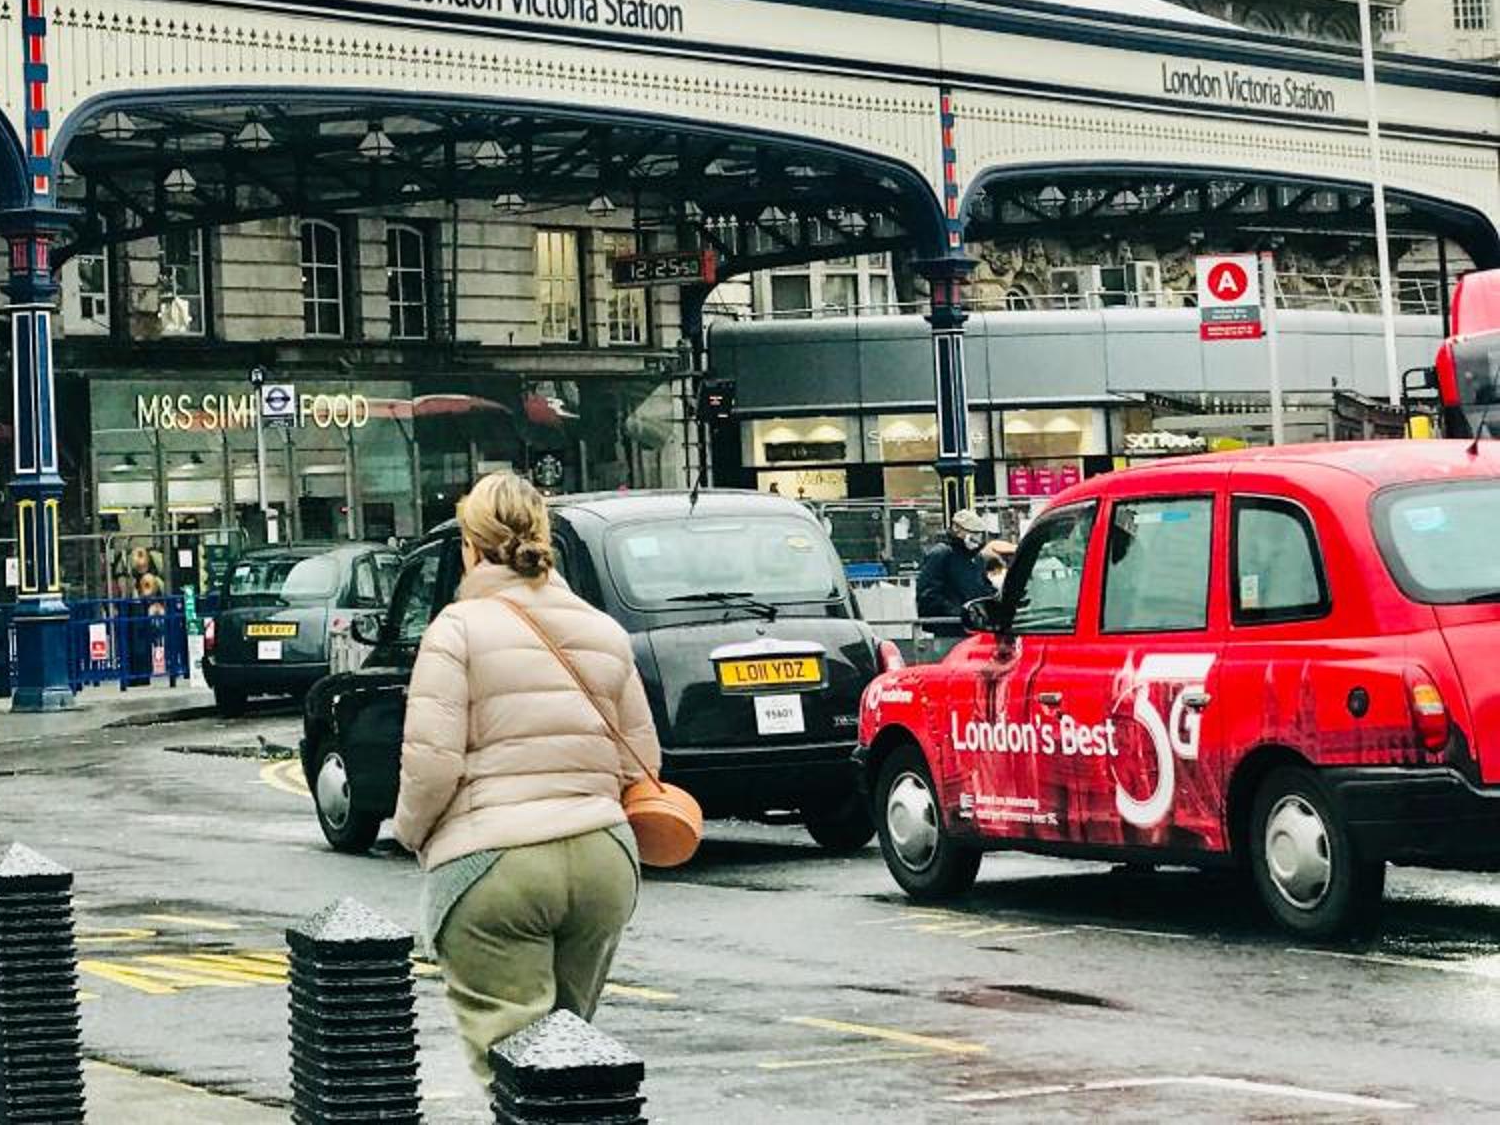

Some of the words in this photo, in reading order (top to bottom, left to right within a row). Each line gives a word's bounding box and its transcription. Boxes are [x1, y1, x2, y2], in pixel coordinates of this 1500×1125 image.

[1162, 61, 1222, 99] London
[1224, 70, 1280, 107] Victoria
[1284, 76, 1336, 113] Station
[1217, 270, 1238, 292] A
[137, 394, 192, 429] M&S
[300, 394, 369, 428] FOOD
[773, 661, 805, 679] YDZ
[951, 711, 1055, 754] London's
[1060, 714, 1119, 756] Best
[1115, 653, 1216, 828] 5G
